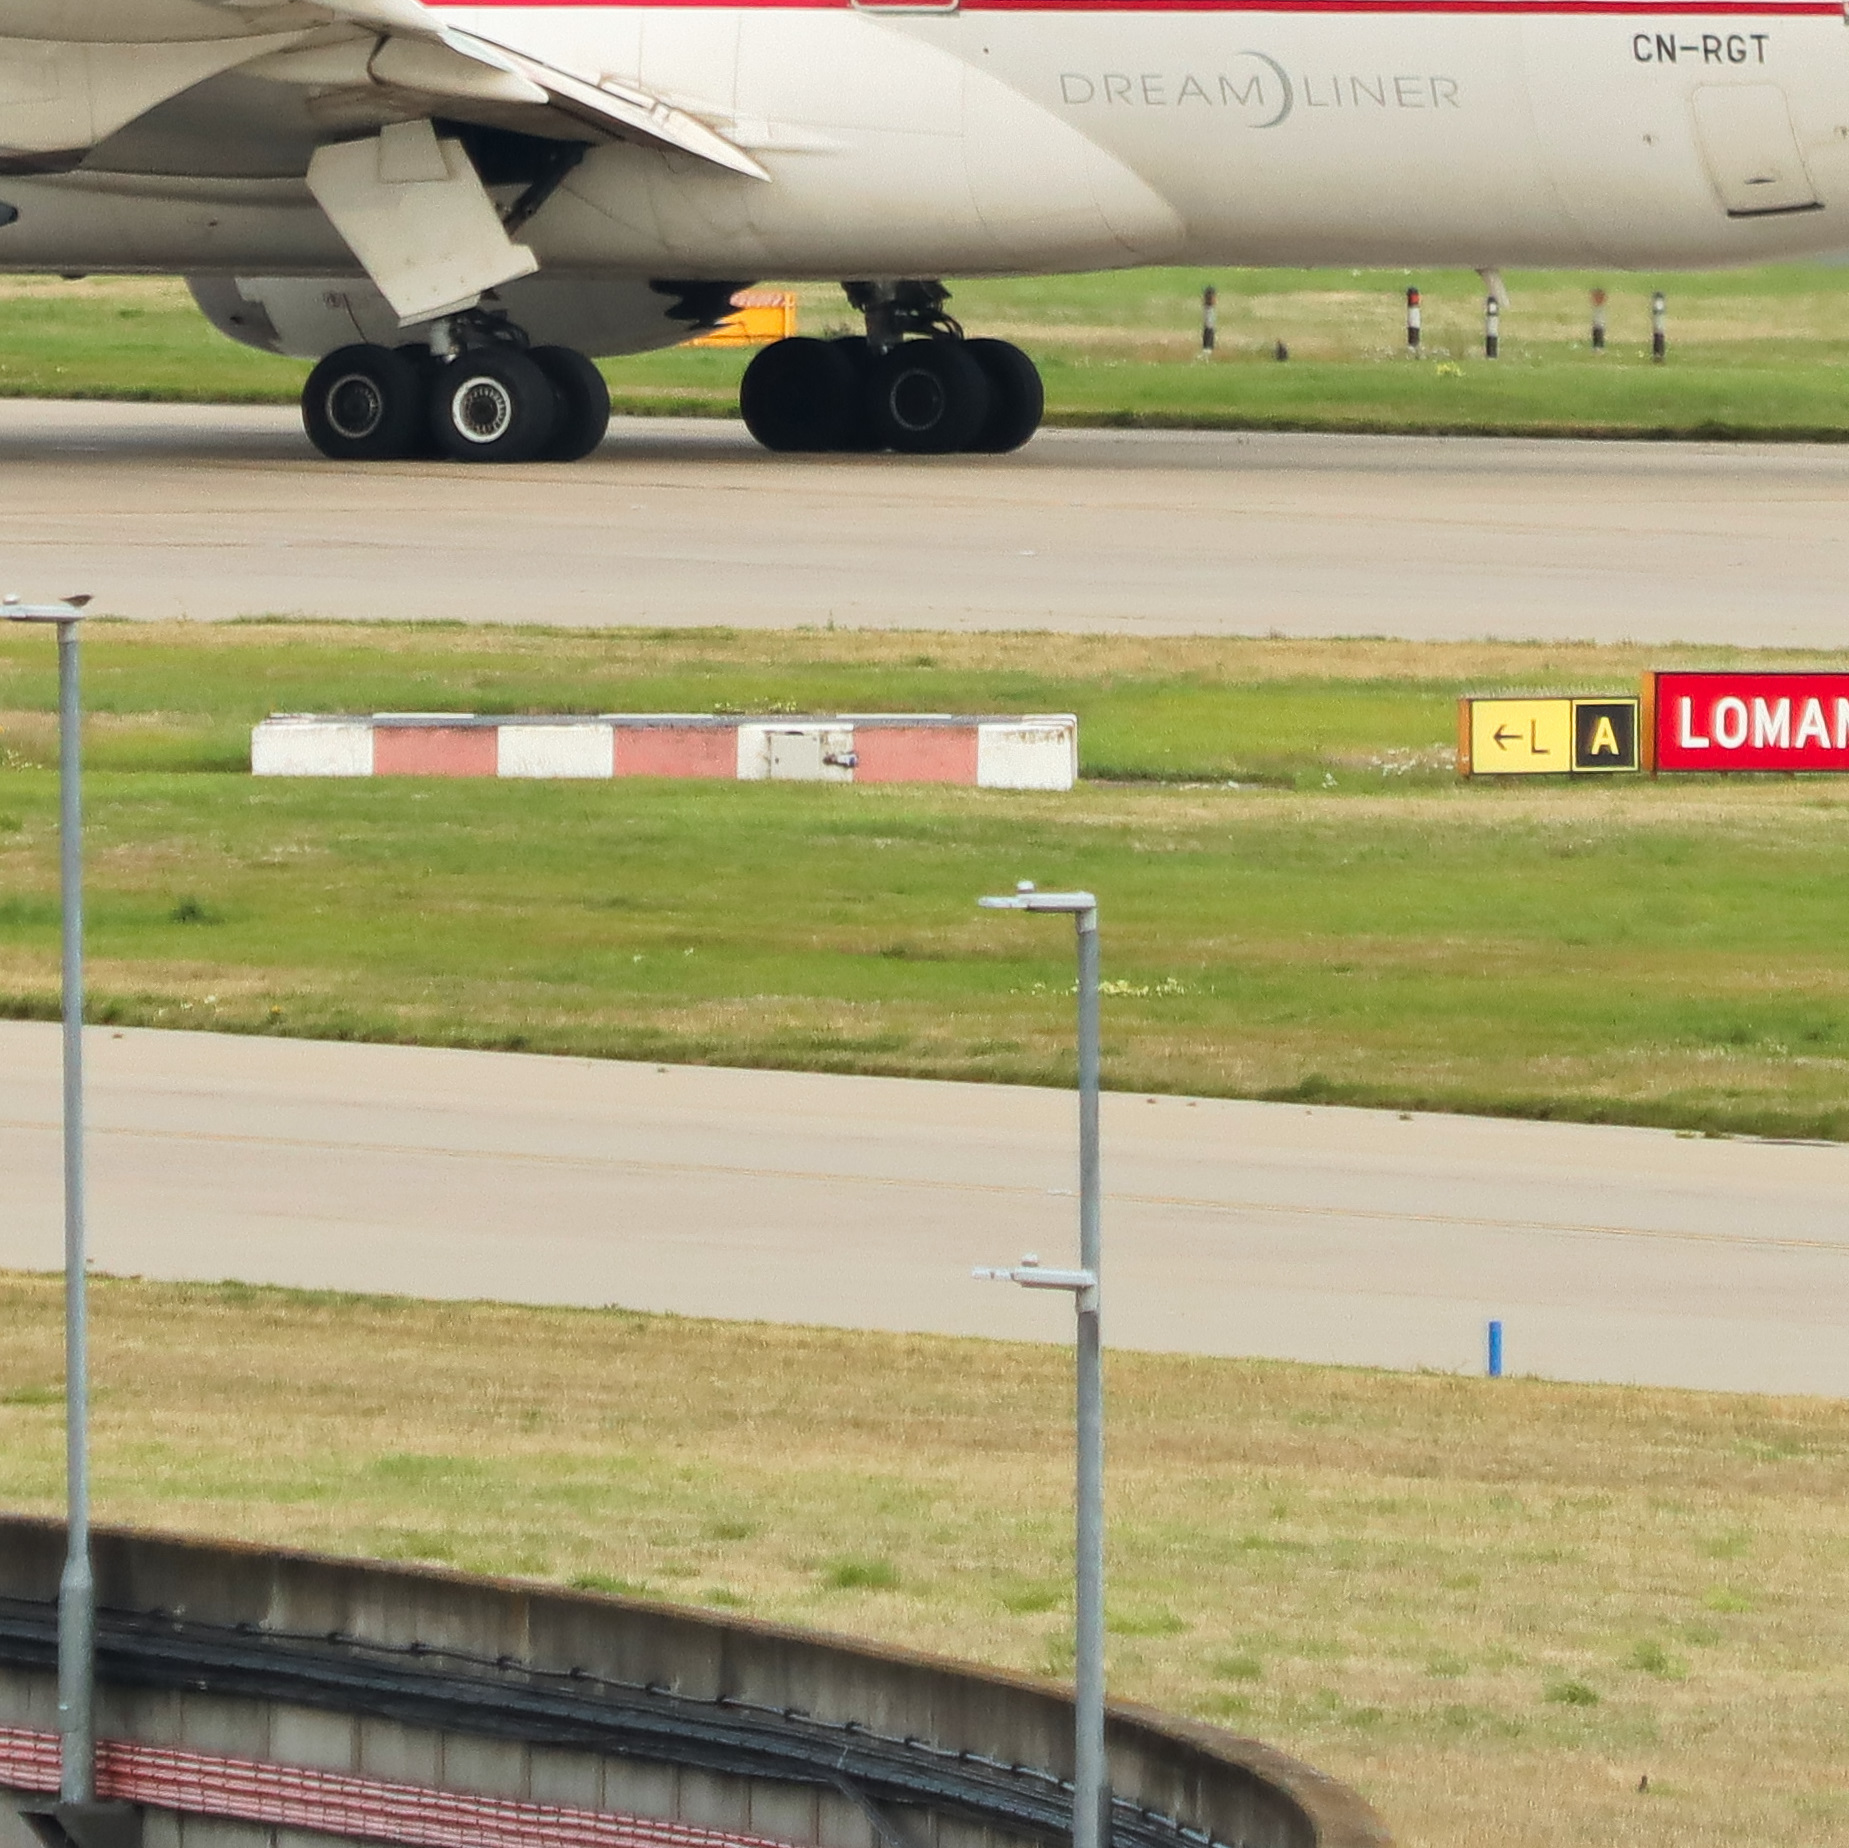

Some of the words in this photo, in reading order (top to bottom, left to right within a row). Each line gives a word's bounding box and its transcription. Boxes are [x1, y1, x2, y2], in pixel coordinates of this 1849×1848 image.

[1633, 34, 1769, 64] CN-RGT
[1530, 719, 1550, 754] L
[1591, 716, 1619, 756] A
